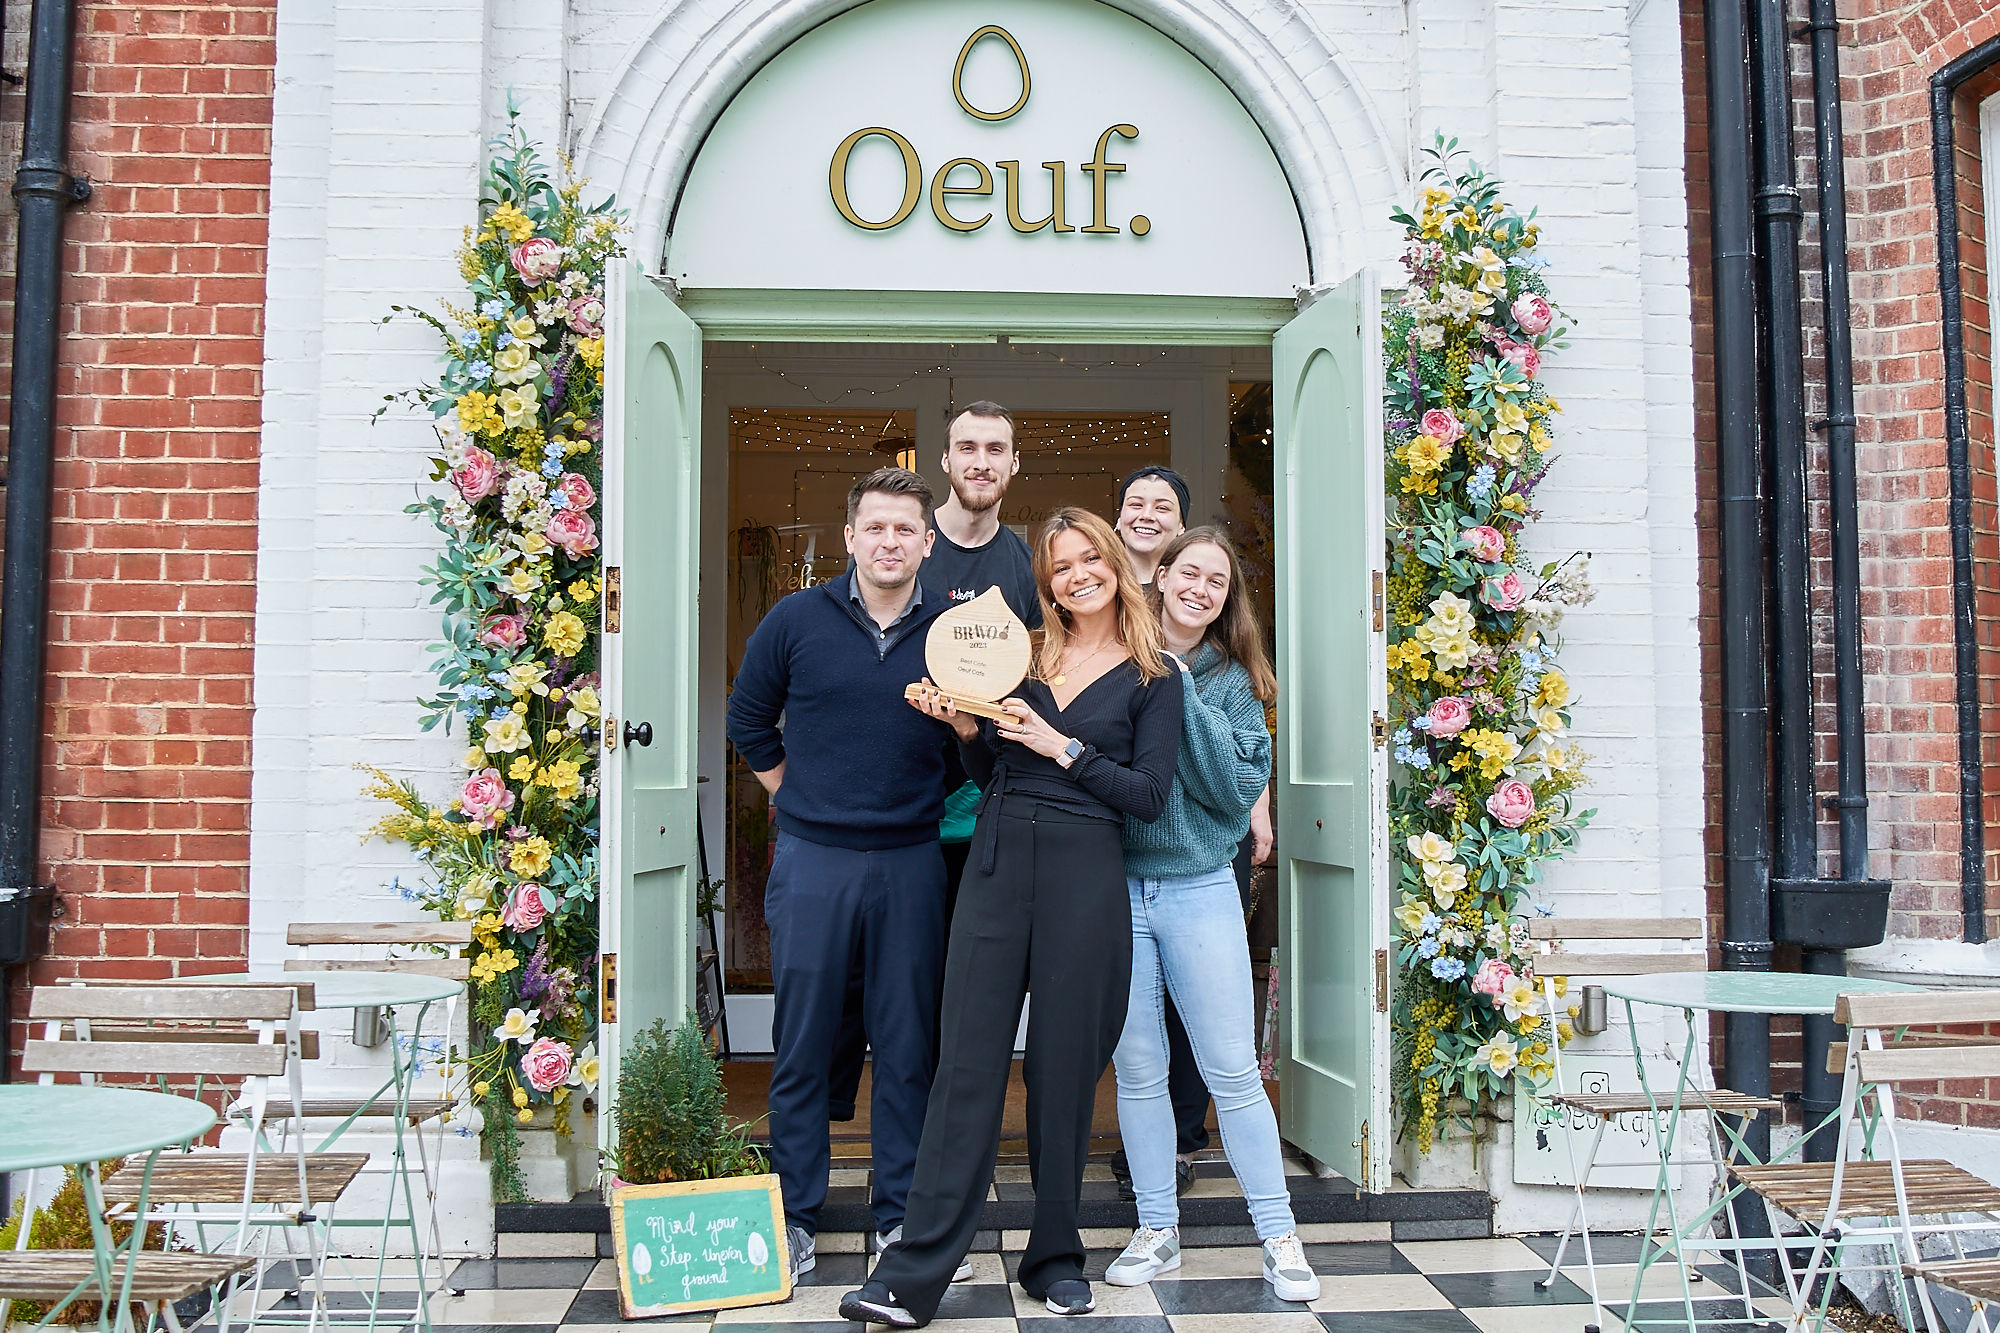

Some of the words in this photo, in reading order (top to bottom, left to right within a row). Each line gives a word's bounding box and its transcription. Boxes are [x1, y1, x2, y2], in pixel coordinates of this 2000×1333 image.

[828, 123, 1152, 237] Oeuf.
[953, 624, 998, 640] BRAVO
[646, 1211, 697, 1243] Mind
[706, 1216, 739, 1246] your
[681, 1266, 729, 1300] ground
